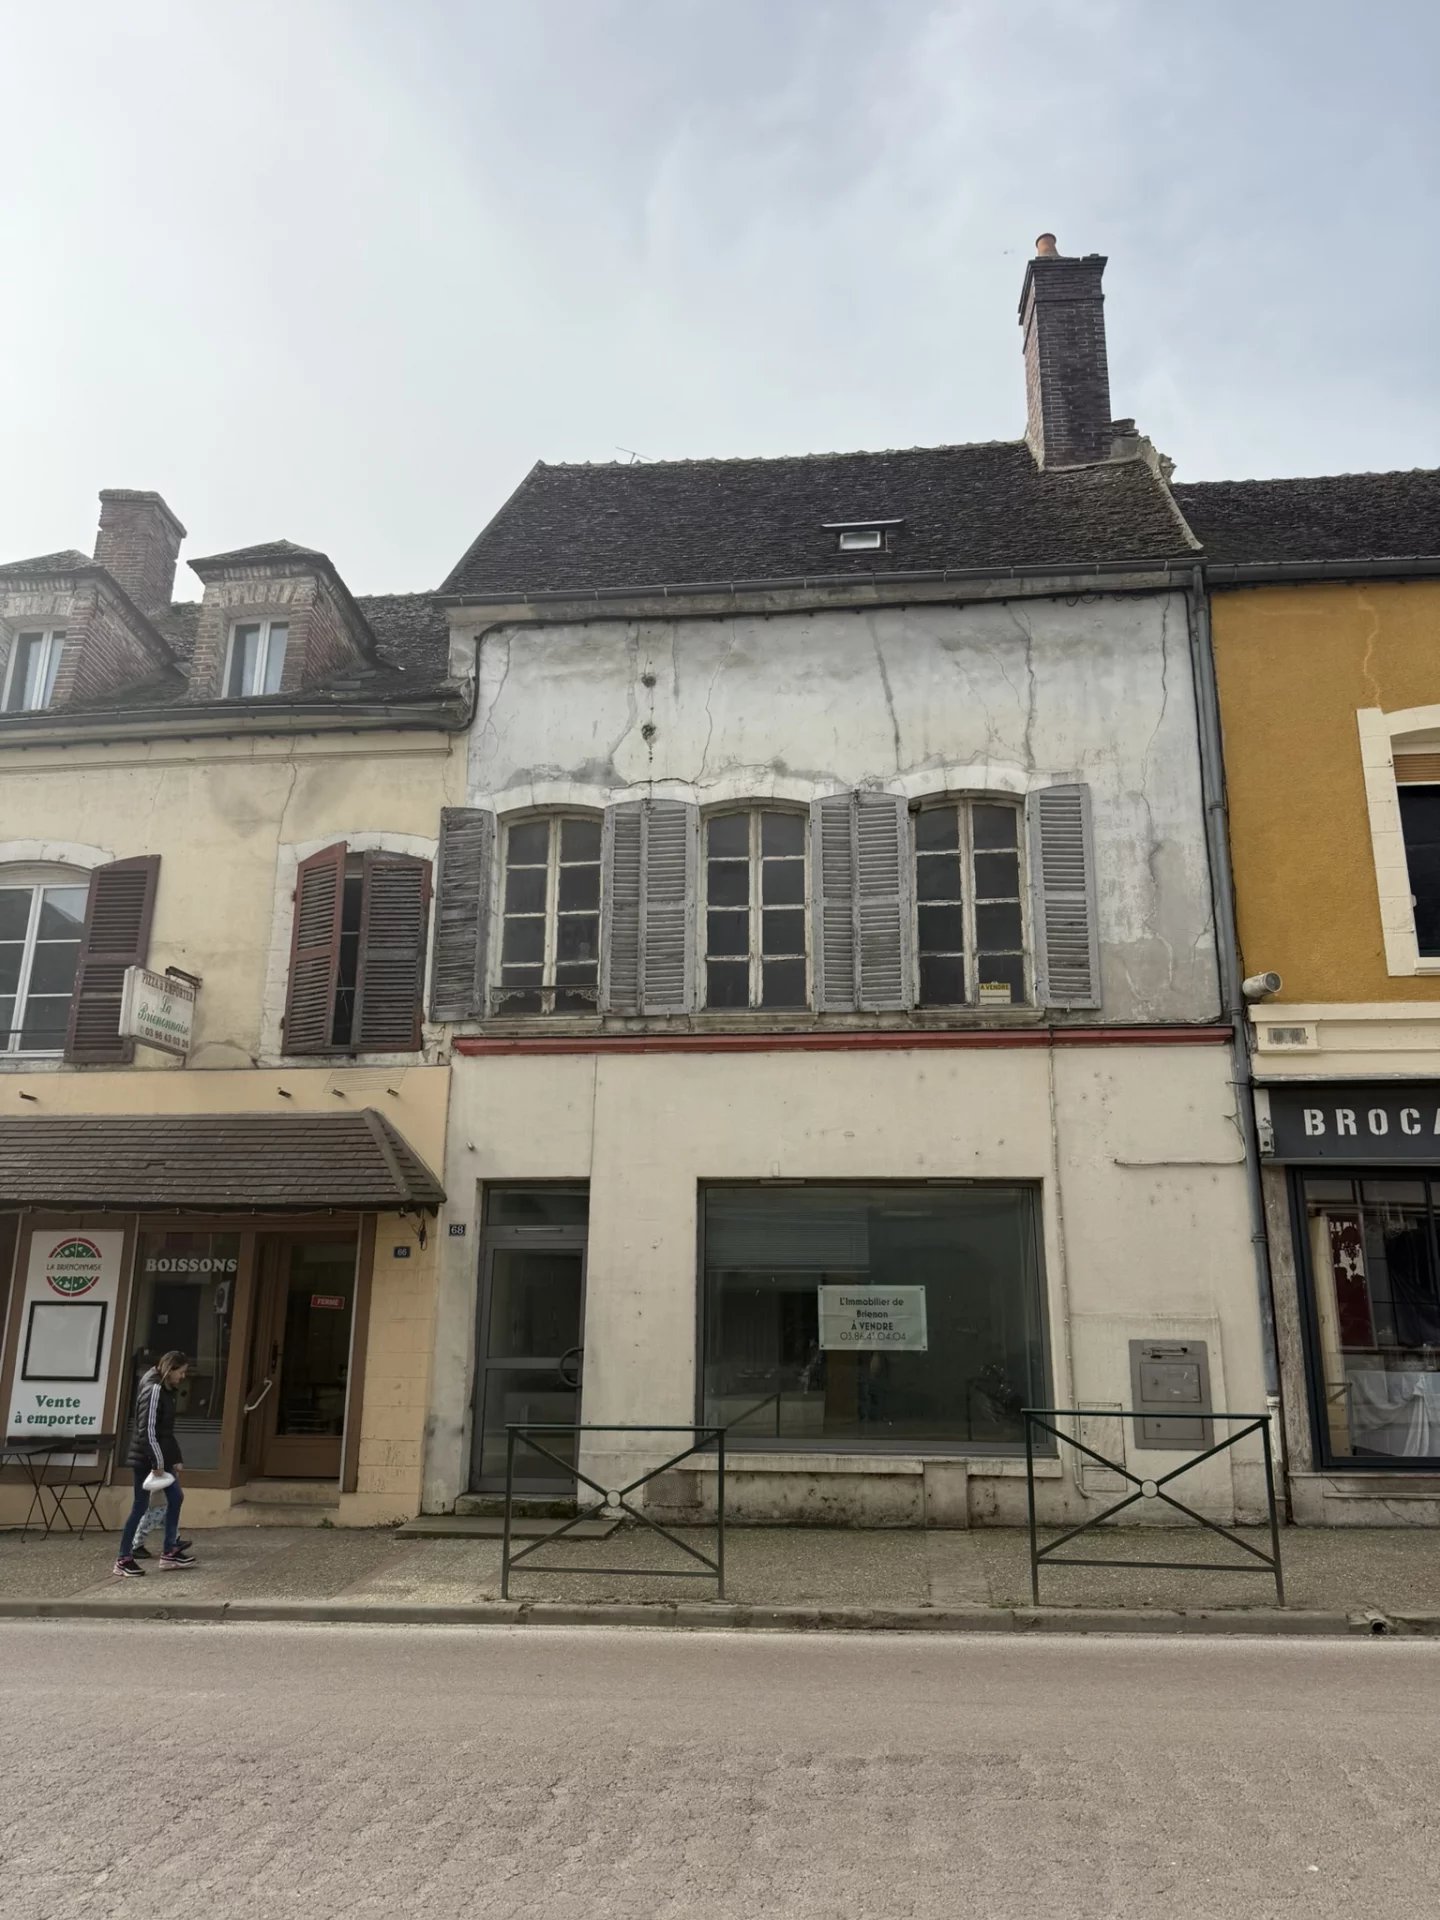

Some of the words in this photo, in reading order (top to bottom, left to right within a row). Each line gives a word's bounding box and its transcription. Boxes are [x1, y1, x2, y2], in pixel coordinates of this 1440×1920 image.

[161, 994, 172, 1015] La
[1303, 1108, 1440, 1135] BROC
[451, 1225, 464, 1234] 68
[46, 1263, 55, 1271] LA
[145, 1258, 238, 1272] BOISSONS
[839, 1297, 890, 1306] L'Immobilier
[892, 1297, 904, 1306] de
[856, 1310, 889, 1318] Brienon
[859, 1321, 894, 1331] VENDRE
[35, 1395, 81, 1408] Vente
[14, 1411, 22, 1423] à
[27, 1414, 96, 1427] emporter
